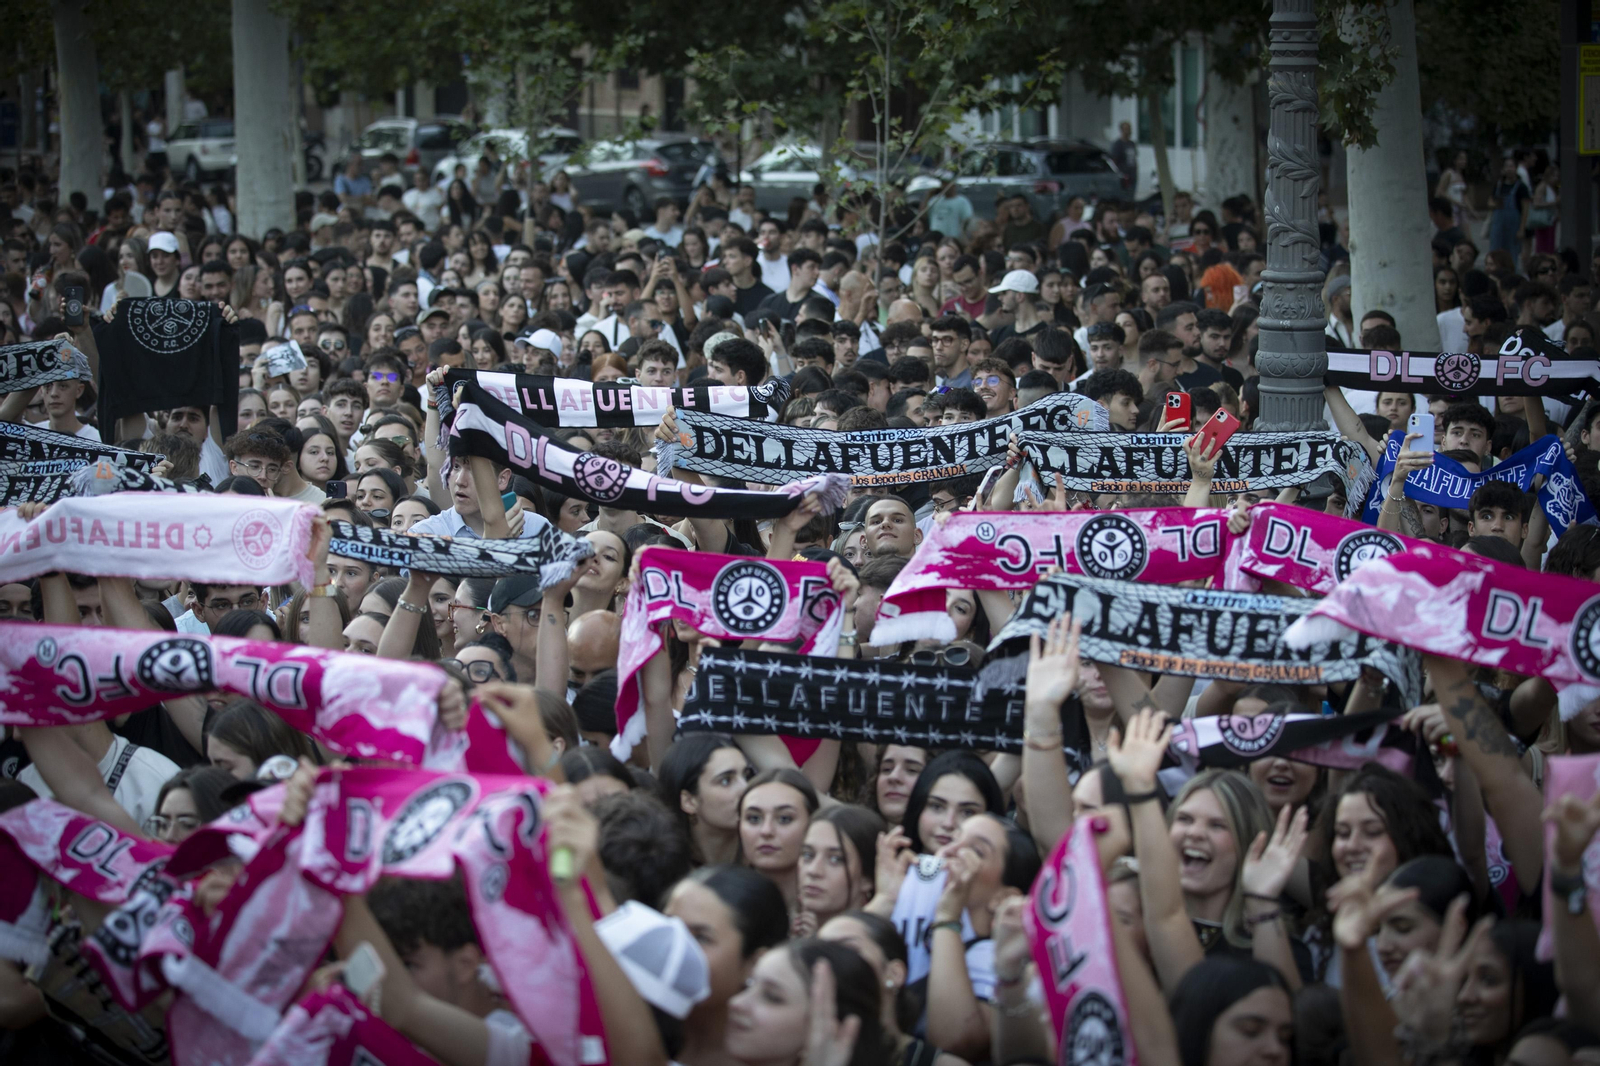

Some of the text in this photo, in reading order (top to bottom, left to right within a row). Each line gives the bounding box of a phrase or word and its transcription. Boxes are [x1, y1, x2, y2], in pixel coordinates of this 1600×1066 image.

[1369, 350, 1424, 384] DL
[1496, 355, 1552, 387] FC
[711, 386, 746, 405] FC
[1077, 410, 1090, 426] 17
[505, 420, 562, 485] DL
[677, 432, 693, 447] 16
[691, 420, 1012, 473] DELLAFUENTE
[846, 429, 923, 443] Diciembre 2022
[1131, 434, 1182, 446] Diciembre
[855, 474, 869, 486] los
[871, 472, 911, 486] deportes
[913, 465, 967, 481] GRANADA
[1090, 481, 1124, 492] Palacio
[1125, 481, 1138, 491] de
[1139, 481, 1152, 492] los
[1210, 480, 1249, 492] ANADA
[998, 534, 1065, 573] FC
[1162, 522, 1219, 560] DL
[1265, 518, 1318, 567] DL
[644, 569, 697, 609] DL
[719, 566, 782, 594] DELLAFUENTE
[739, 621, 754, 630] F.C.
[1484, 590, 1551, 648] DL
[57, 654, 134, 702] FC
[234, 659, 302, 705] DL
[1005, 699, 1024, 725] F
[70, 825, 128, 877] DL
